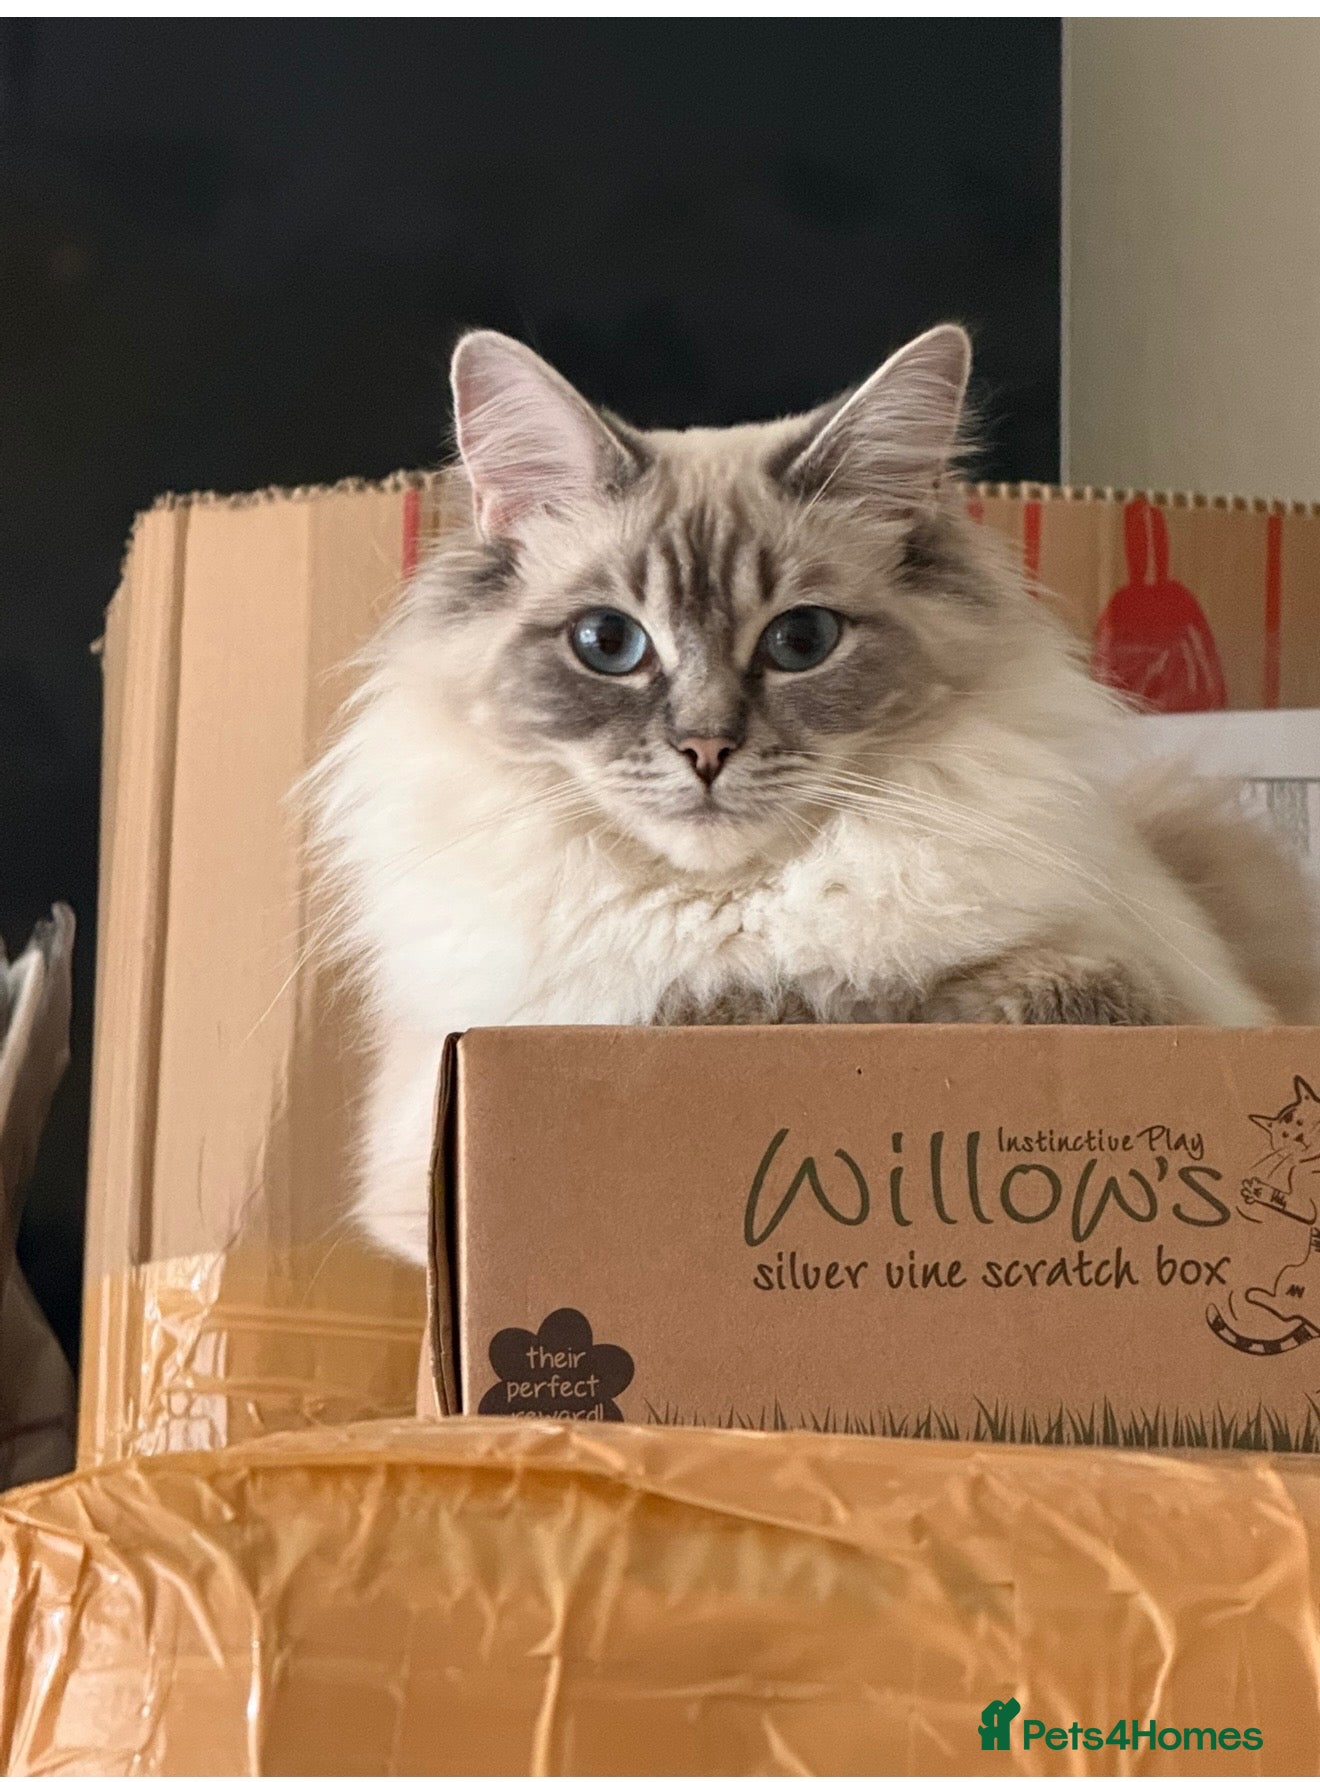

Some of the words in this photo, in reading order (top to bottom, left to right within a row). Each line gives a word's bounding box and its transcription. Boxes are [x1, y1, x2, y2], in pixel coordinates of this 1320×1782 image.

[998, 1126, 1133, 1153] Instinctive
[1137, 1126, 1204, 1160] Play
[744, 1128, 1231, 1247] Willow's
[753, 1251, 868, 1290] silver
[887, 1251, 967, 1288] vine
[982, 1247, 1138, 1288] scratch
[1157, 1244, 1231, 1287] box
[525, 1345, 586, 1369] their
[506, 1374, 600, 1402] perfect
